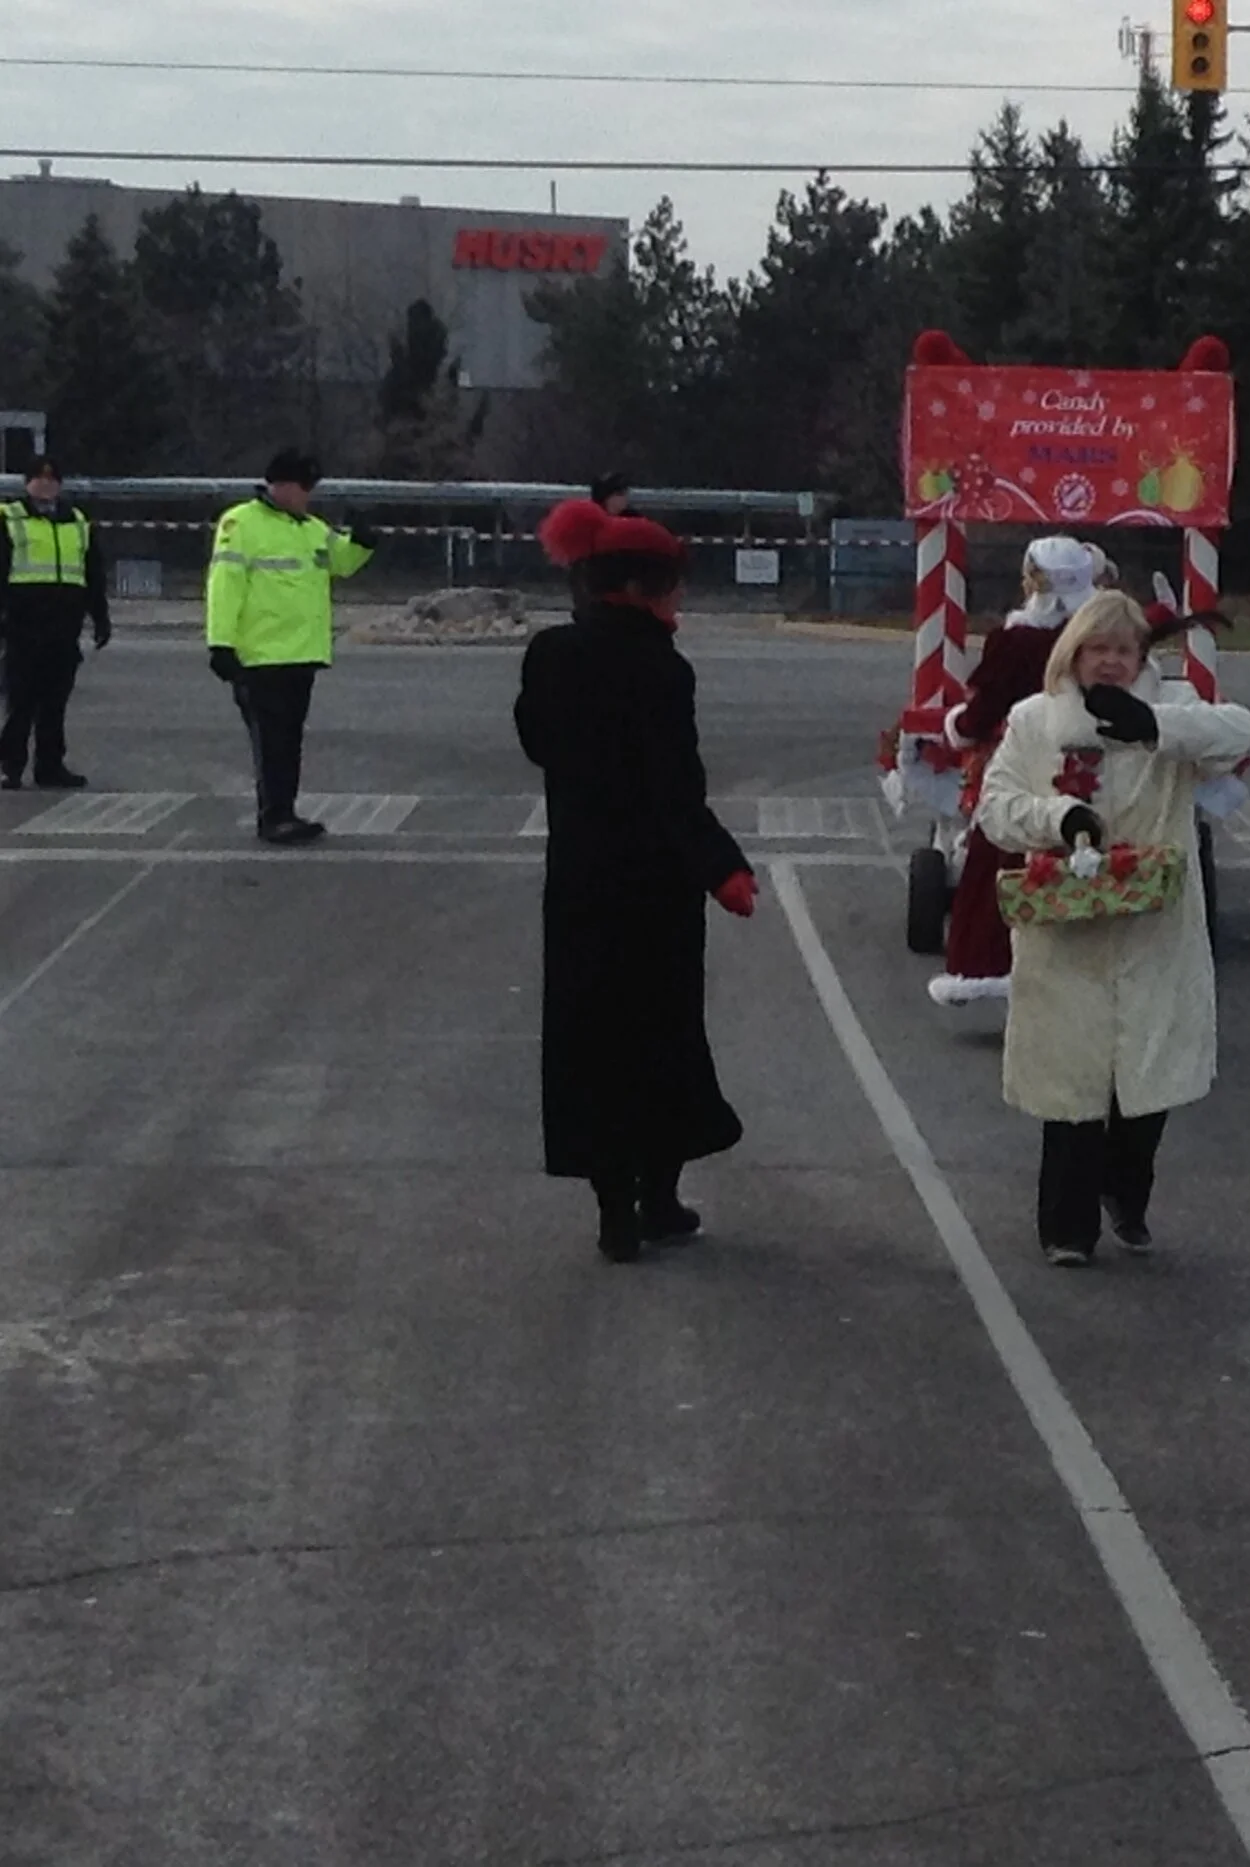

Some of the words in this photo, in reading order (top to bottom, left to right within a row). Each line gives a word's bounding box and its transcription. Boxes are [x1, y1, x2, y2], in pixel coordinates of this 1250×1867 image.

[453, 229, 608, 272] HUSKY
[1041, 390, 1107, 414] Candy
[1009, 414, 1108, 438] provided
[1112, 415, 1139, 441] by
[1030, 447, 1115, 463] MARS
